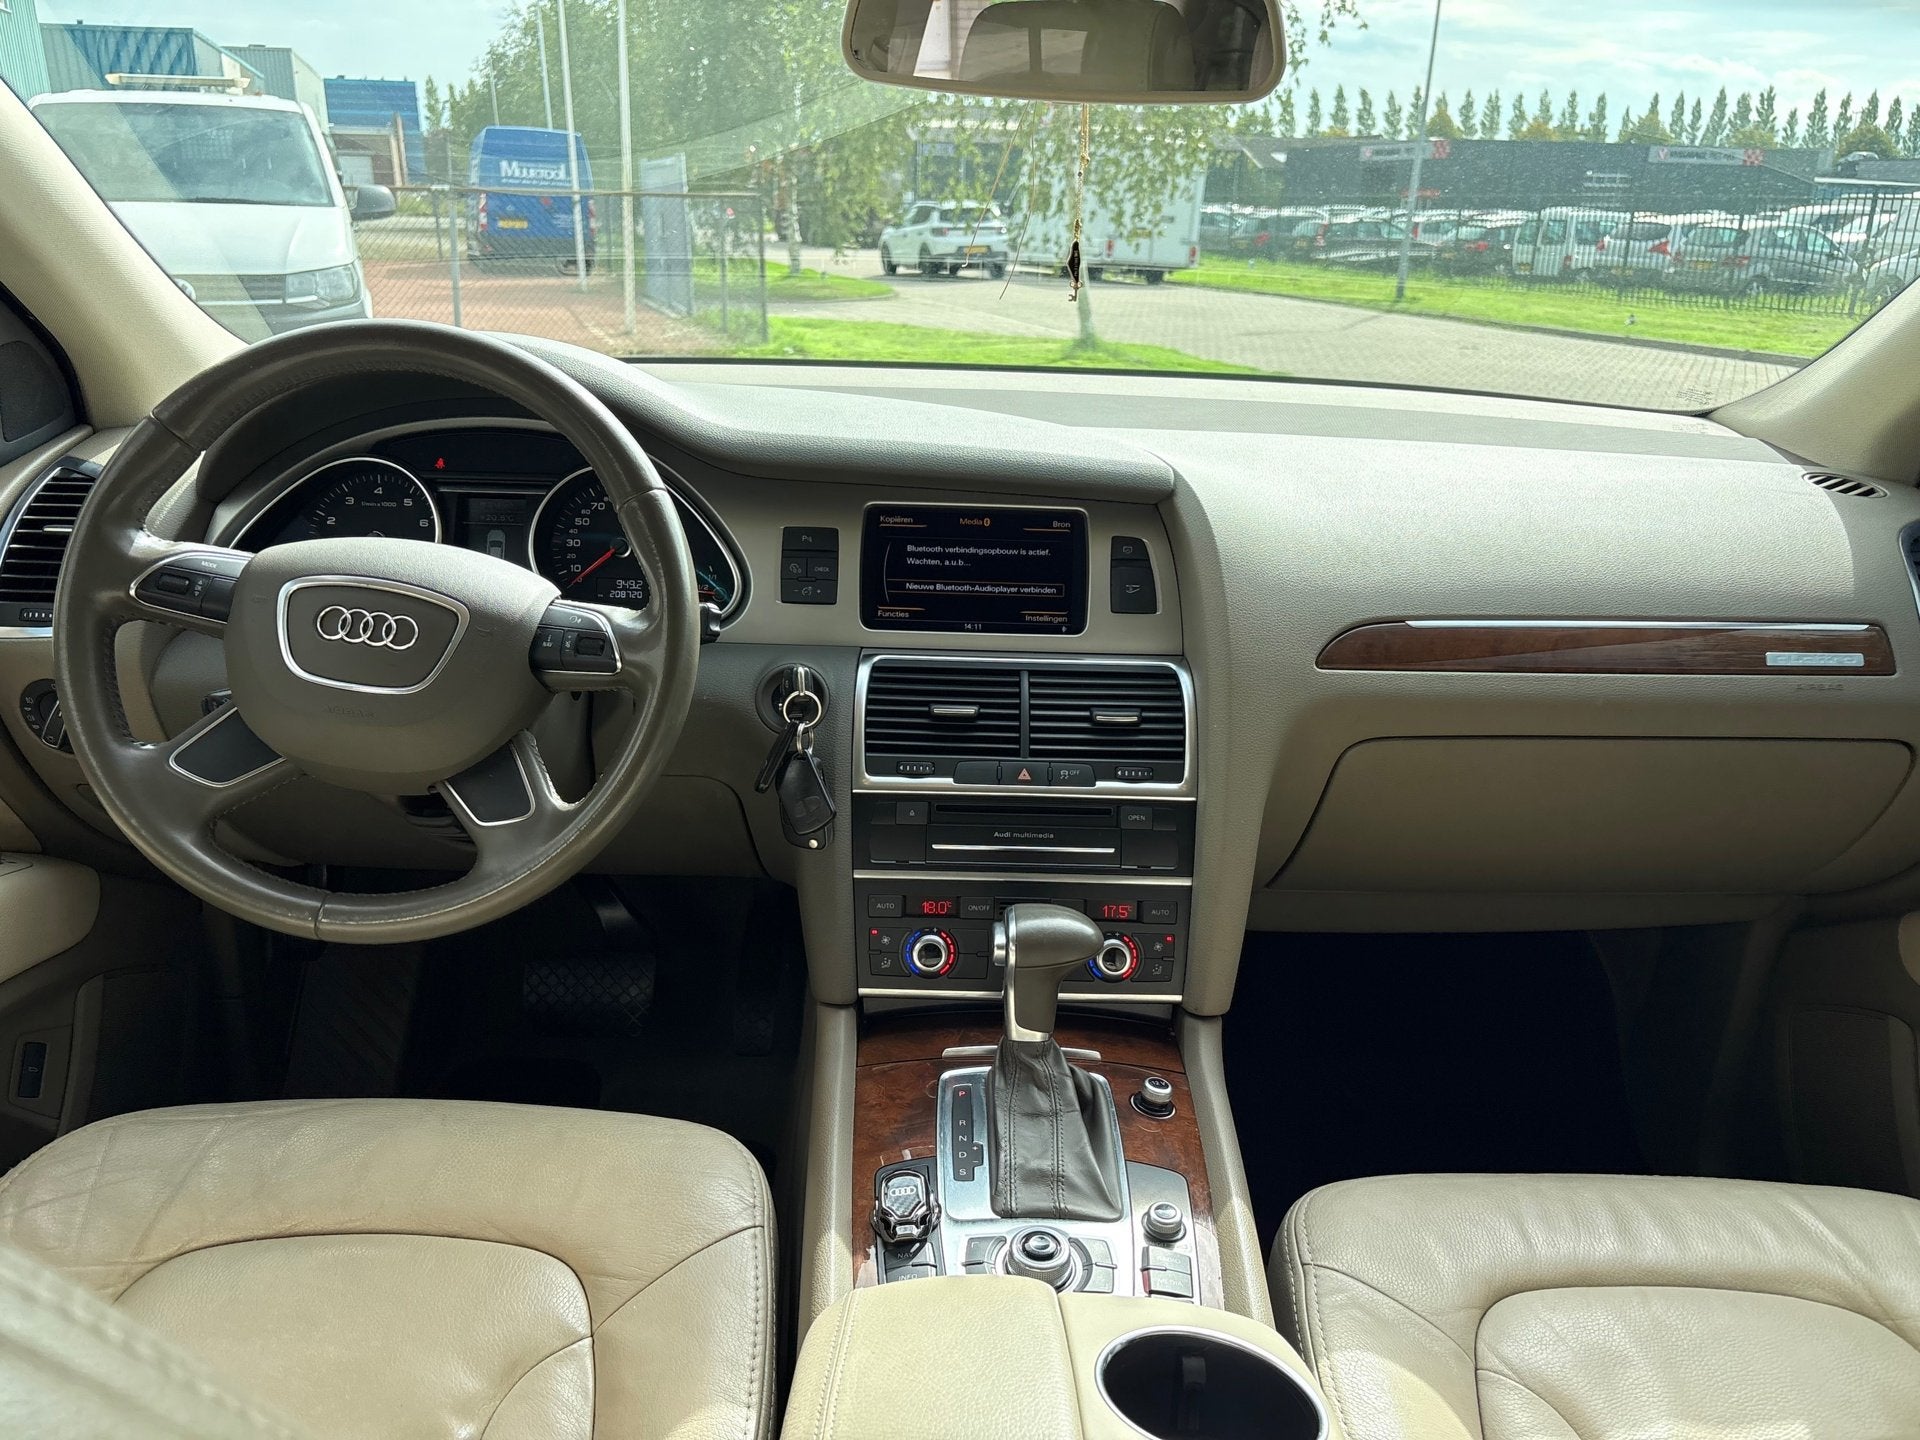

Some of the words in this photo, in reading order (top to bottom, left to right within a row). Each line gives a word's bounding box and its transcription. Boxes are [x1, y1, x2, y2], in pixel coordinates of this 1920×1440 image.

[374, 487, 383, 495] 4
[345, 496, 355, 505] 3
[403, 498, 413, 507] 5
[590, 502, 606, 511] 70
[326, 516, 336, 525] 2
[419, 519, 429, 527] 6
[574, 517, 590, 526] 50
[879, 515, 913, 524] Kopiëren
[959, 518, 983, 526] Media
[566, 539, 581, 547] 30
[906, 544, 943, 553] Bluetooth
[944, 546, 1019, 556] verbindingsopbouw
[1019, 548, 1027, 556] is
[1028, 548, 1051, 556] actief.
[906, 557, 942, 566] Wachten,
[570, 564, 582, 572] 10
[906, 582, 934, 591] Nieuwe
[935, 583, 1018, 594] Bluetooth-Audioplayer
[1019, 586, 1057, 594] verbinden
[609, 590, 643, 599] 208720
[877, 610, 910, 618] Functies
[1025, 615, 1068, 623] Instellingen
[1127, 814, 1146, 822] OPEN
[993, 830, 1011, 839] Audi
[1012, 831, 1054, 839] multimedia
[876, 902, 895, 910] AUTO
[967, 903, 990, 912] ON/OFF
[1151, 908, 1170, 917] AUTO
[958, 1090, 967, 1098] P
[959, 1168, 967, 1176] S
